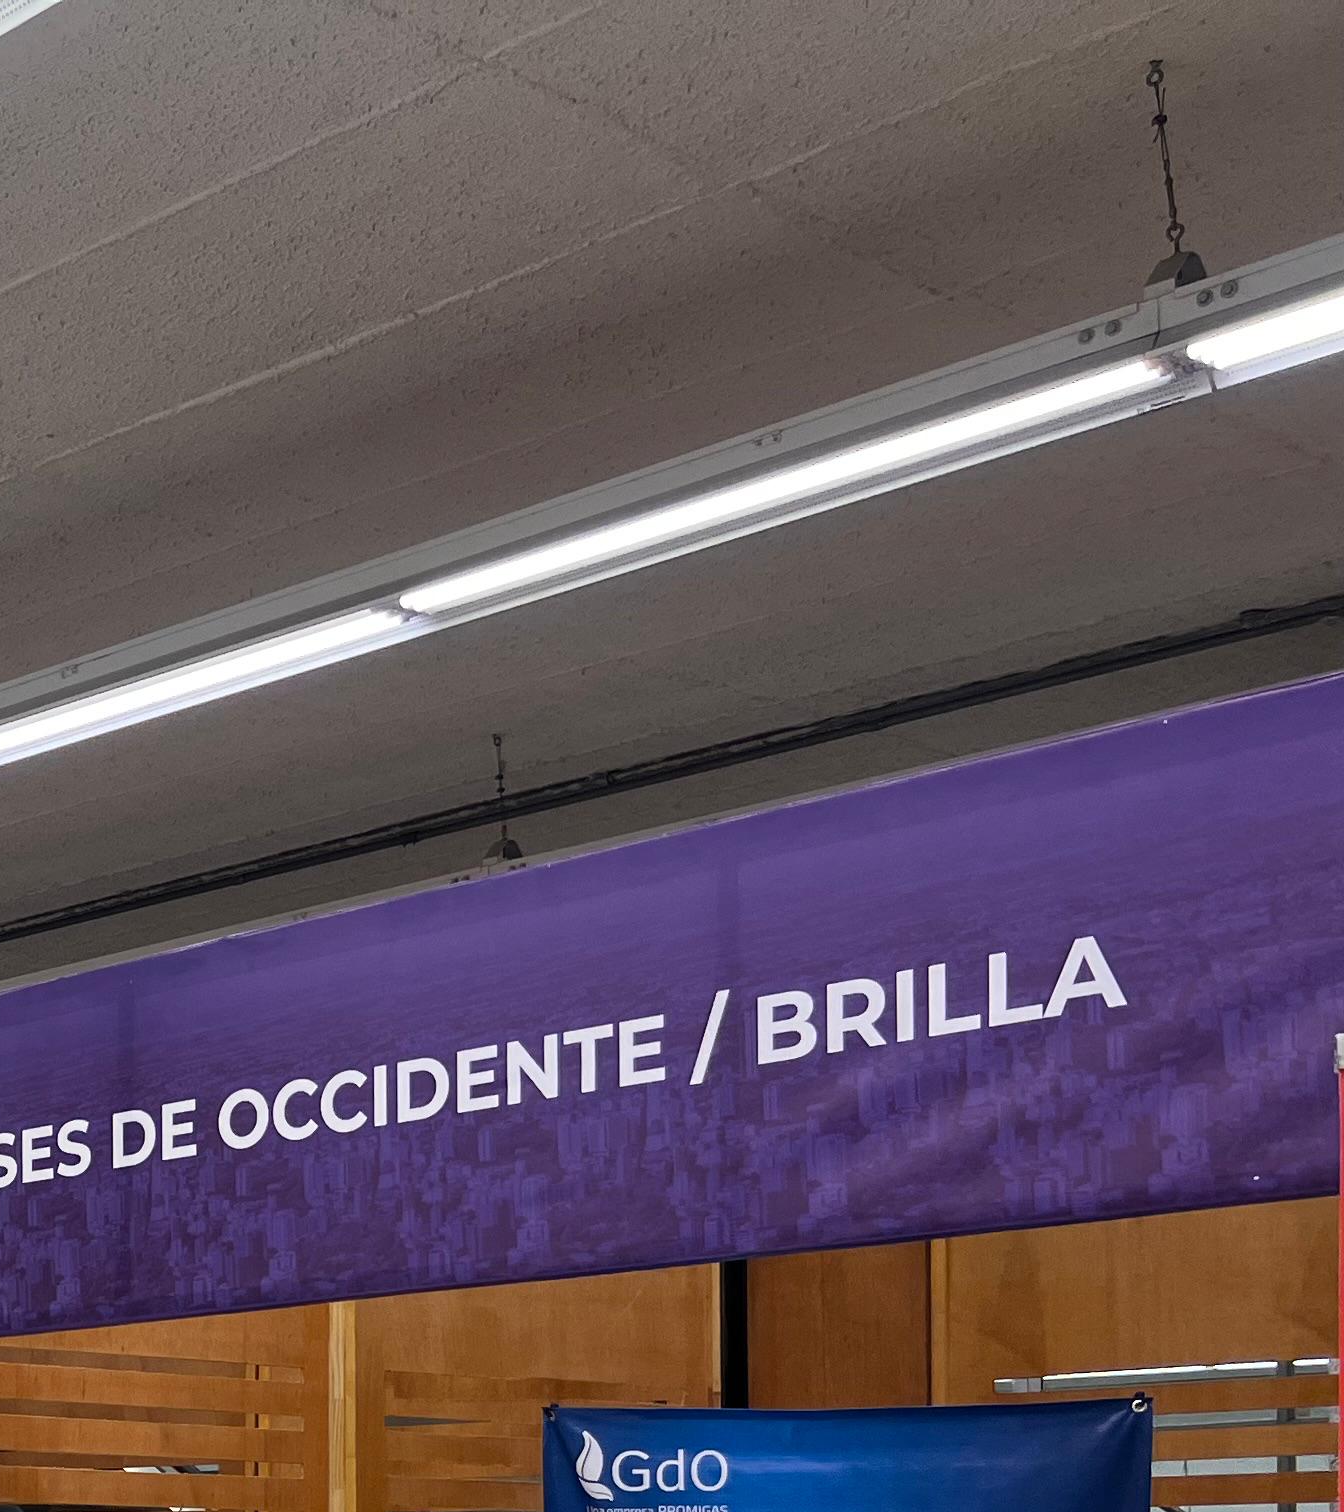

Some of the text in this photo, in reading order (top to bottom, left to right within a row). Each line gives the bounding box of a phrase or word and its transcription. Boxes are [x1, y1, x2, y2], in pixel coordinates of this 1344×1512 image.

[113, 1098, 198, 1172] DE
[217, 1014, 667, 1153] OCCIDENTE
[689, 989, 732, 1086] /
[755, 935, 1128, 1066] BRILLA
[612, 1448, 729, 1493] GdO
